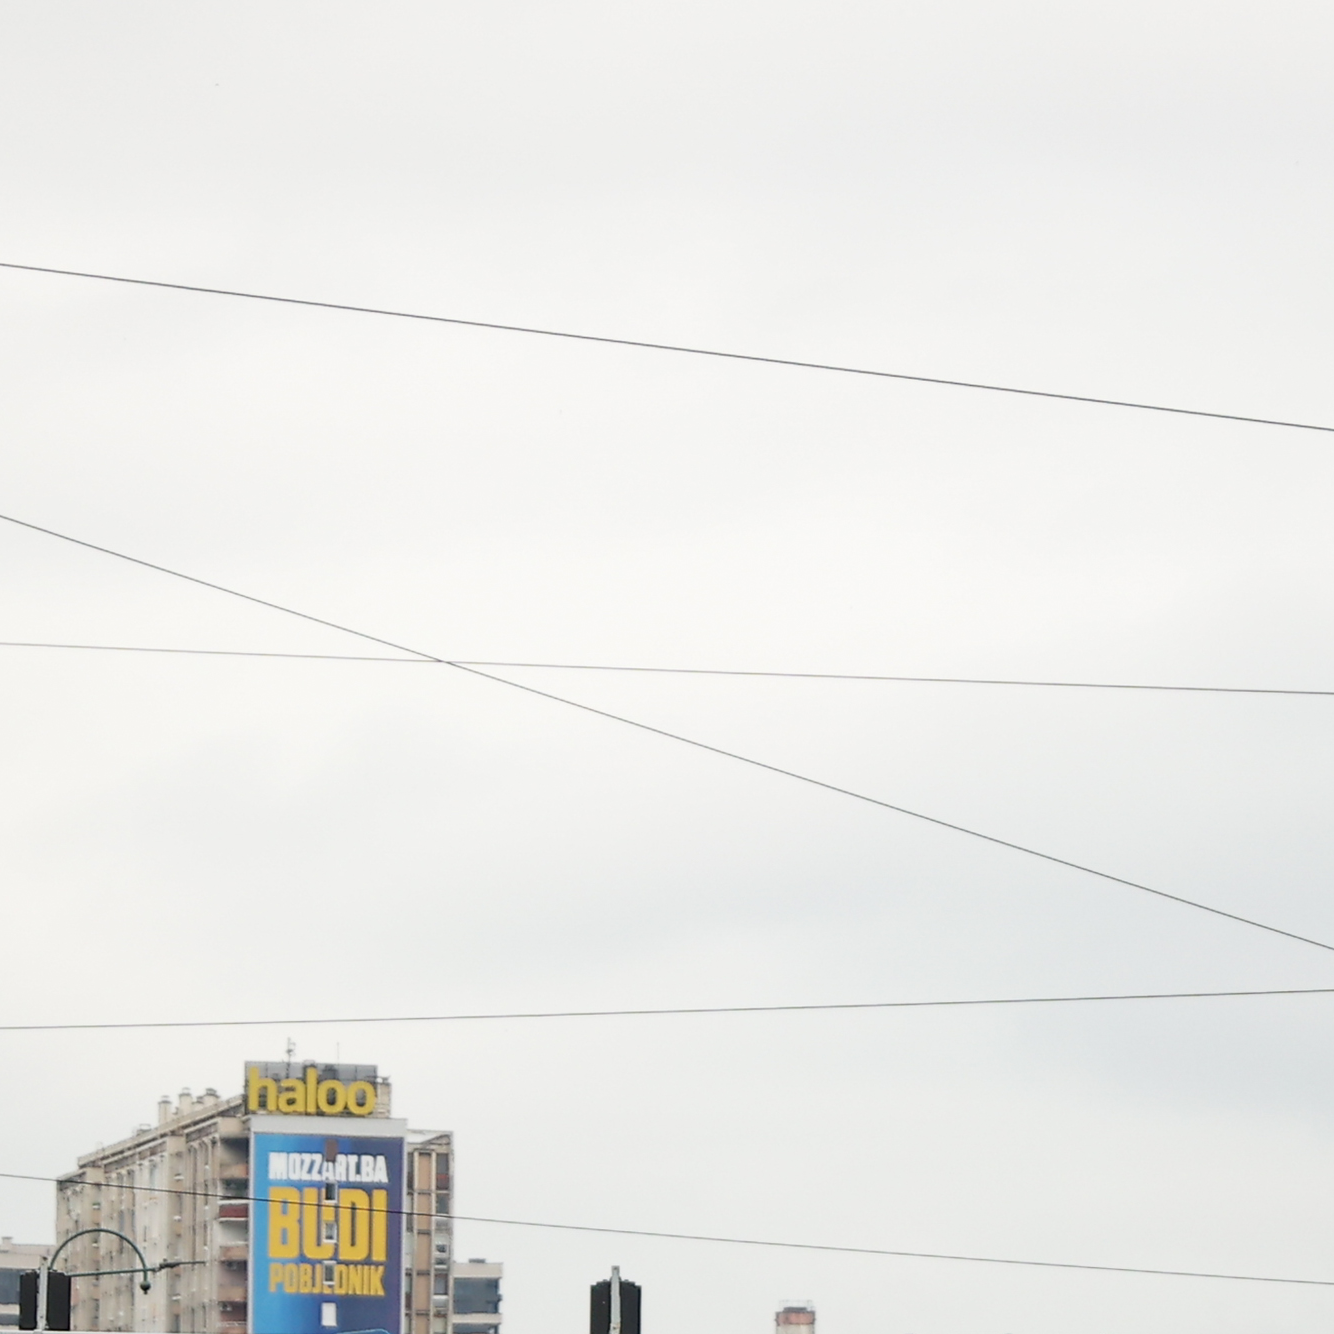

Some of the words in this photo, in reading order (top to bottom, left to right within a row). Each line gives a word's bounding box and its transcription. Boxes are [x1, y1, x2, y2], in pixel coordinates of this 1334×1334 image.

[248, 1066, 377, 1115] haloo
[268, 1152, 389, 1183] MOZZART.BA
[269, 1186, 388, 1262] BUDI
[269, 1263, 386, 1296] POBJDNIK
